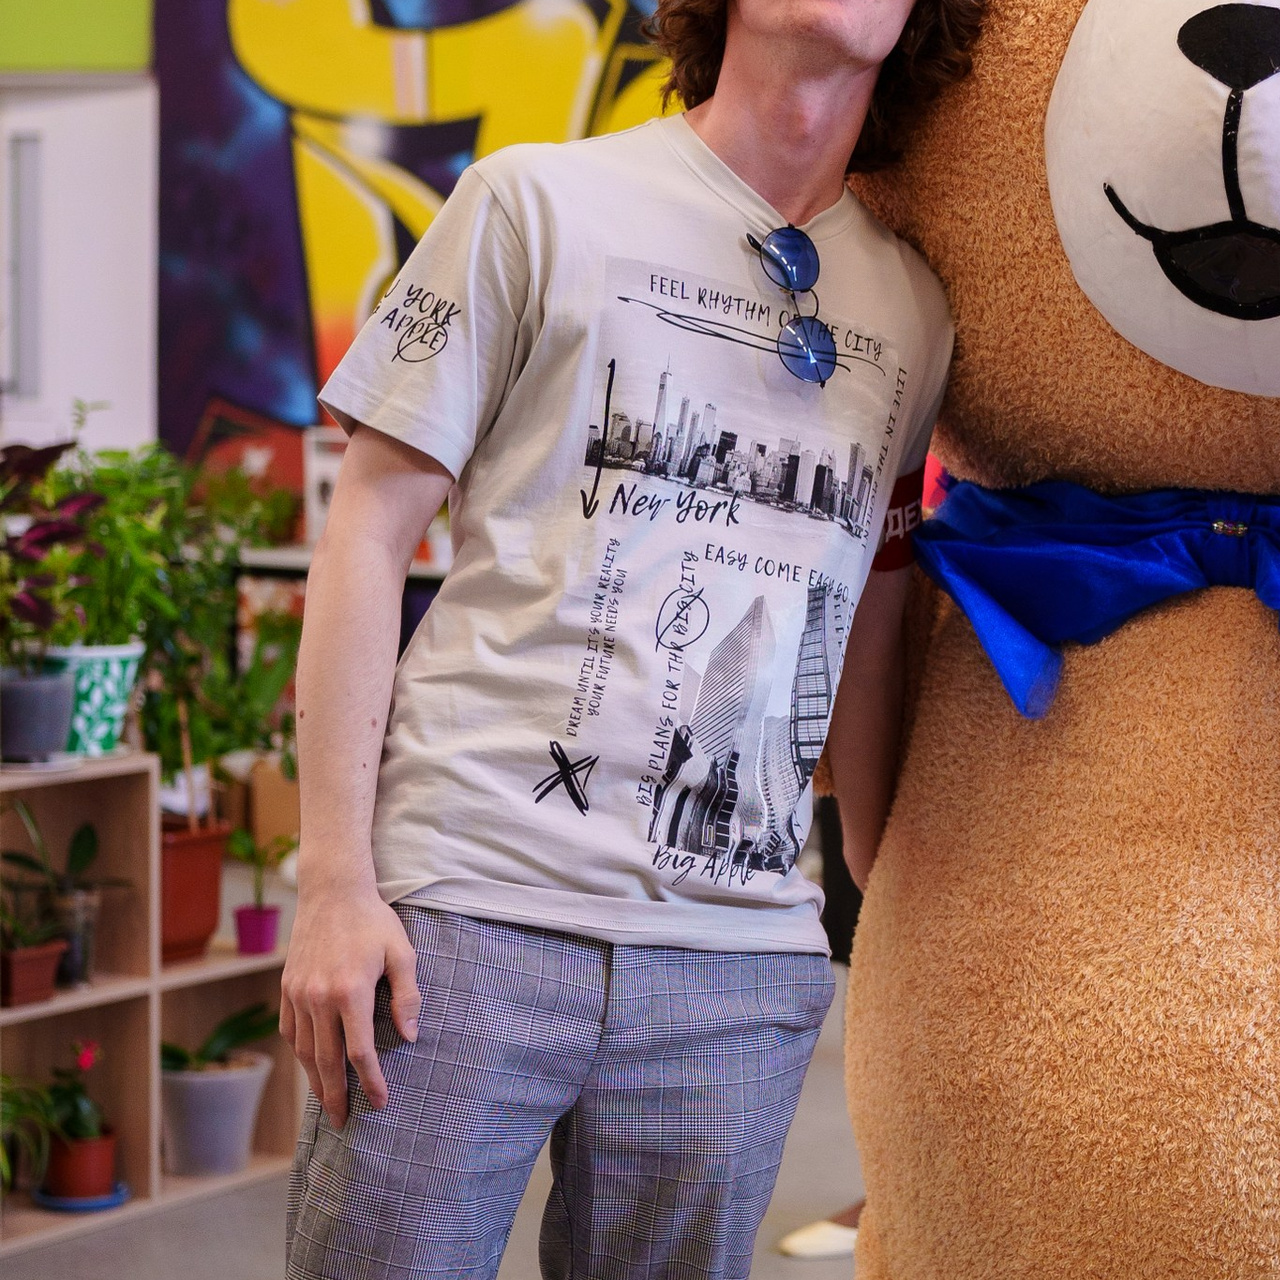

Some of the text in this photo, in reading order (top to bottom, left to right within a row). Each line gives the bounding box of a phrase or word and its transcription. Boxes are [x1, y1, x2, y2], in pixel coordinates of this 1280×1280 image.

[403, 284, 461, 327] YORK
[649, 274, 690, 300] FEEL
[698, 286, 771, 327] RHYTHM
[807, 319, 839, 345] THE
[844, 329, 883, 362] CITY
[380, 307, 446, 351] APPLE
[892, 367, 908, 409] LIVE
[885, 411, 897, 439] IN
[876, 444, 889, 477] THE
[608, 483, 740, 527] New York
[884, 497, 921, 543] ДЕ
[678, 550, 699, 594] CITY
[704, 543, 850, 603] EASY COME EASY GO
[566, 537, 621, 738] DREAM UNTIL IT'S YOUR REALITY
[672, 600, 692, 636] BIG
[587, 568, 628, 717] YOUR FUTURE NEEDS YOU
[662, 678, 682, 712] FOR
[647, 716, 674, 771] PLANS
[636, 774, 657, 807] BIG
[652, 844, 757, 888] Big Apple
